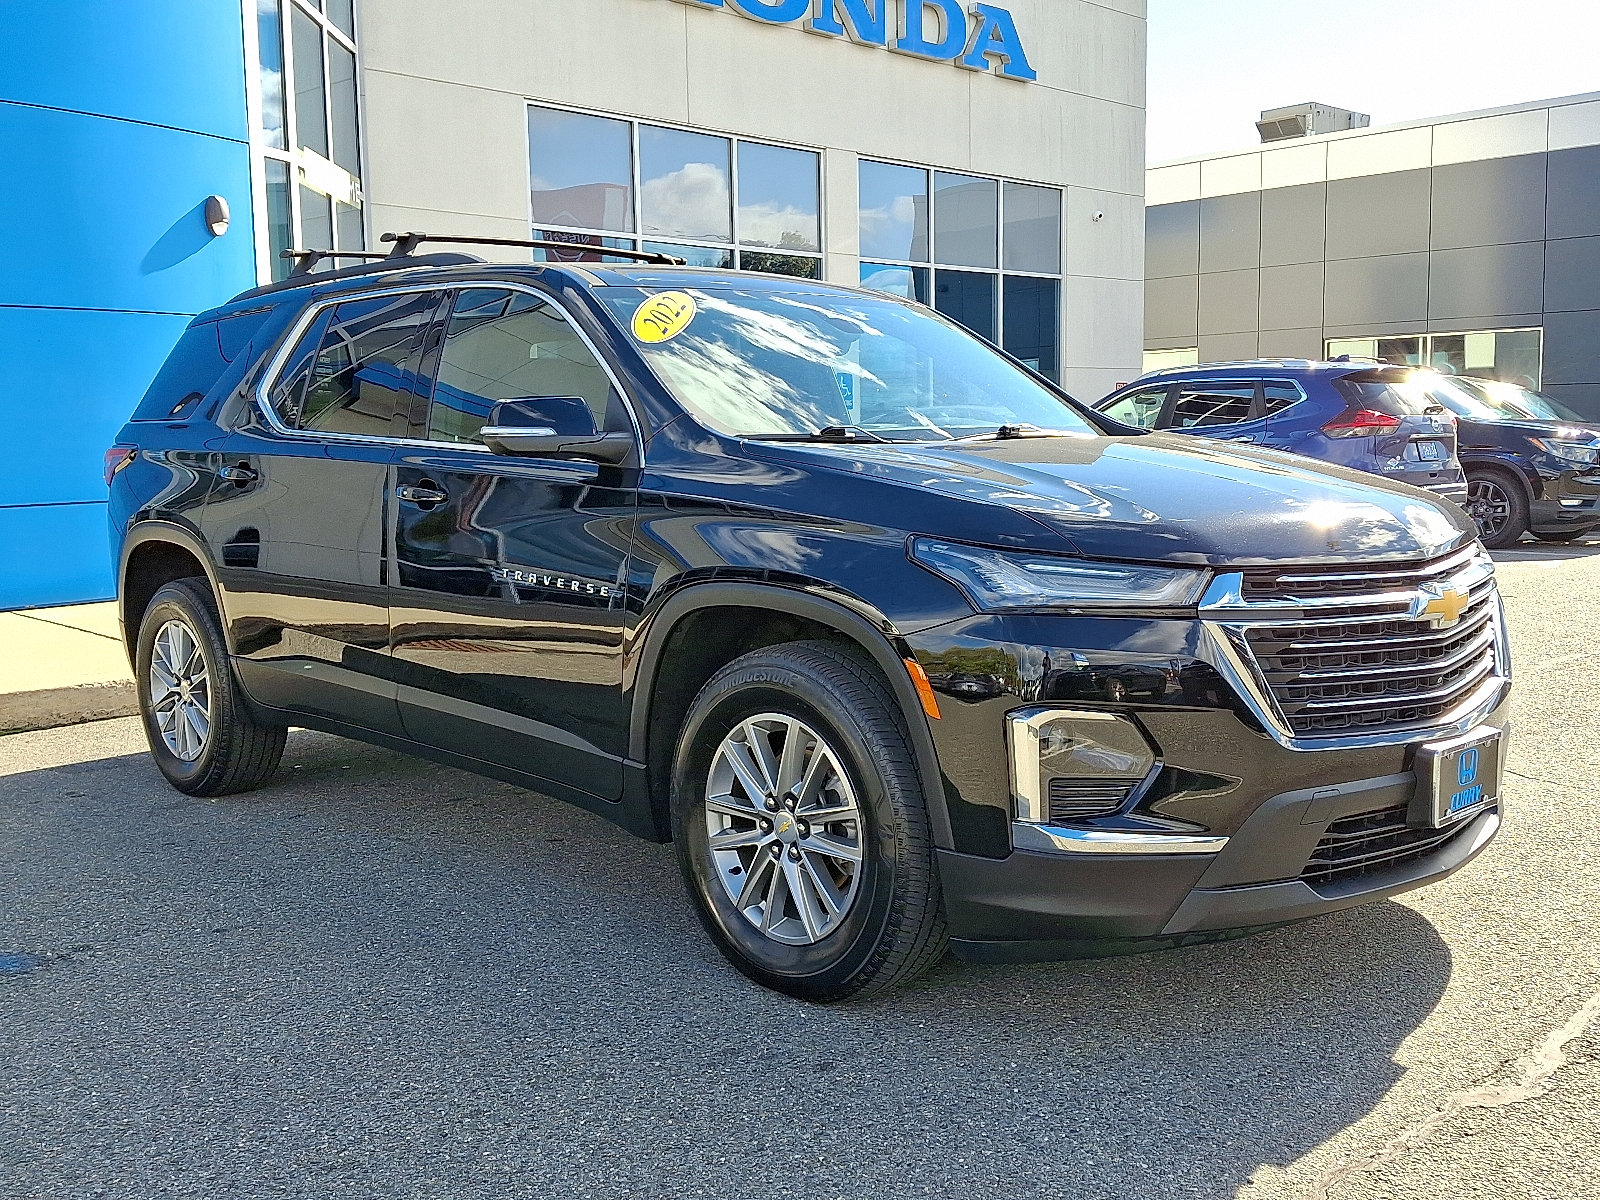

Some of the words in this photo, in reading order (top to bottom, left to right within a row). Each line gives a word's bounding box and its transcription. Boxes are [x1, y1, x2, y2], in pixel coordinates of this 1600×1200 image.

[672, 0, 1037, 82] NDA
[643, 296, 687, 335] 2022
[501, 568, 610, 597] TRAVERSE
[720, 671, 794, 692] BRIDGESTONE
[1450, 783, 1483, 812] CURRY
